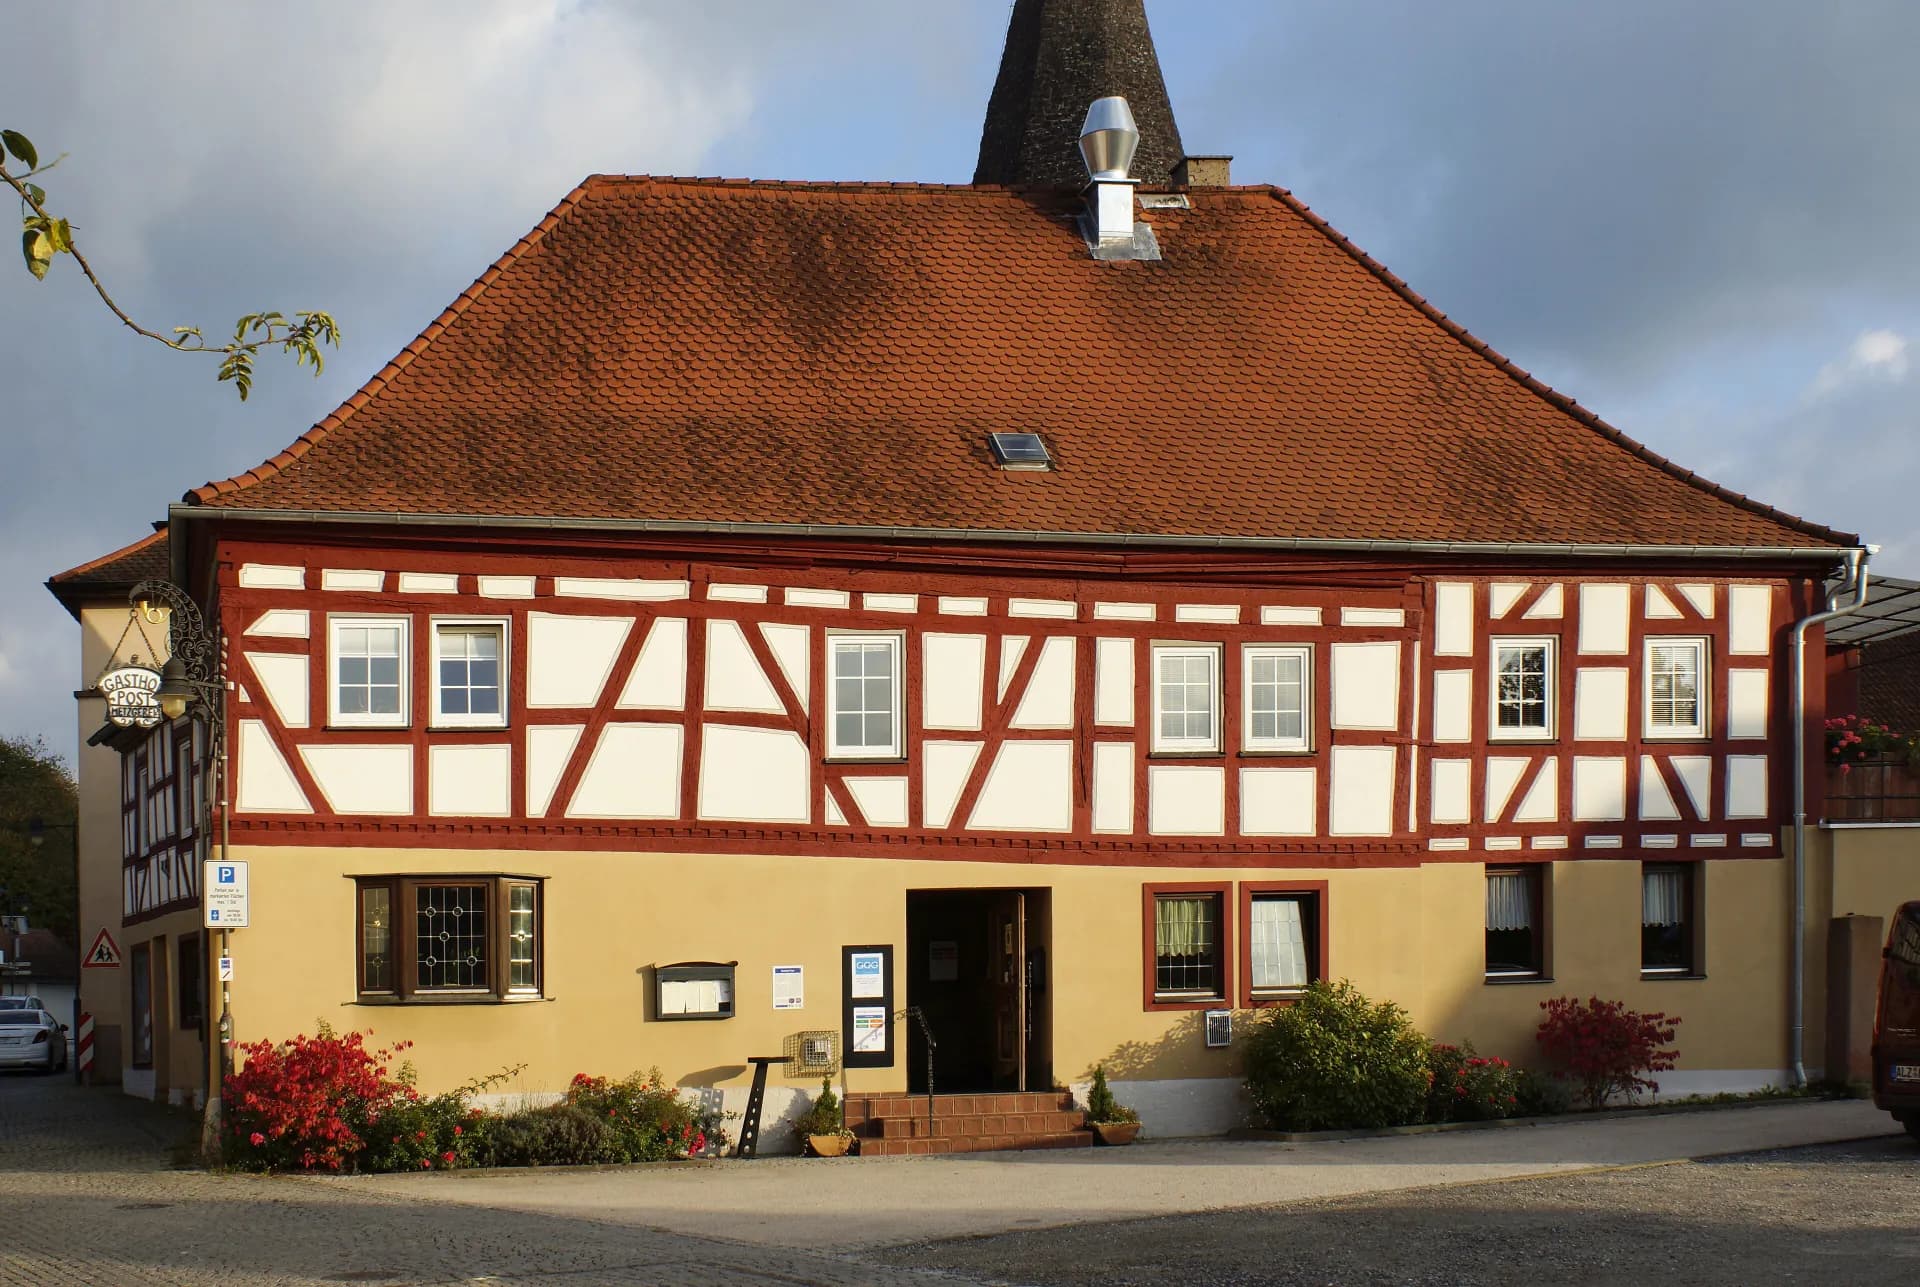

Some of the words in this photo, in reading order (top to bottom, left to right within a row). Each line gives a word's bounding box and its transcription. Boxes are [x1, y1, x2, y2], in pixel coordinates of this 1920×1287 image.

[104, 674, 158, 692] GASTHO
[117, 691, 152, 706] POST
[221, 868, 231, 882] P
